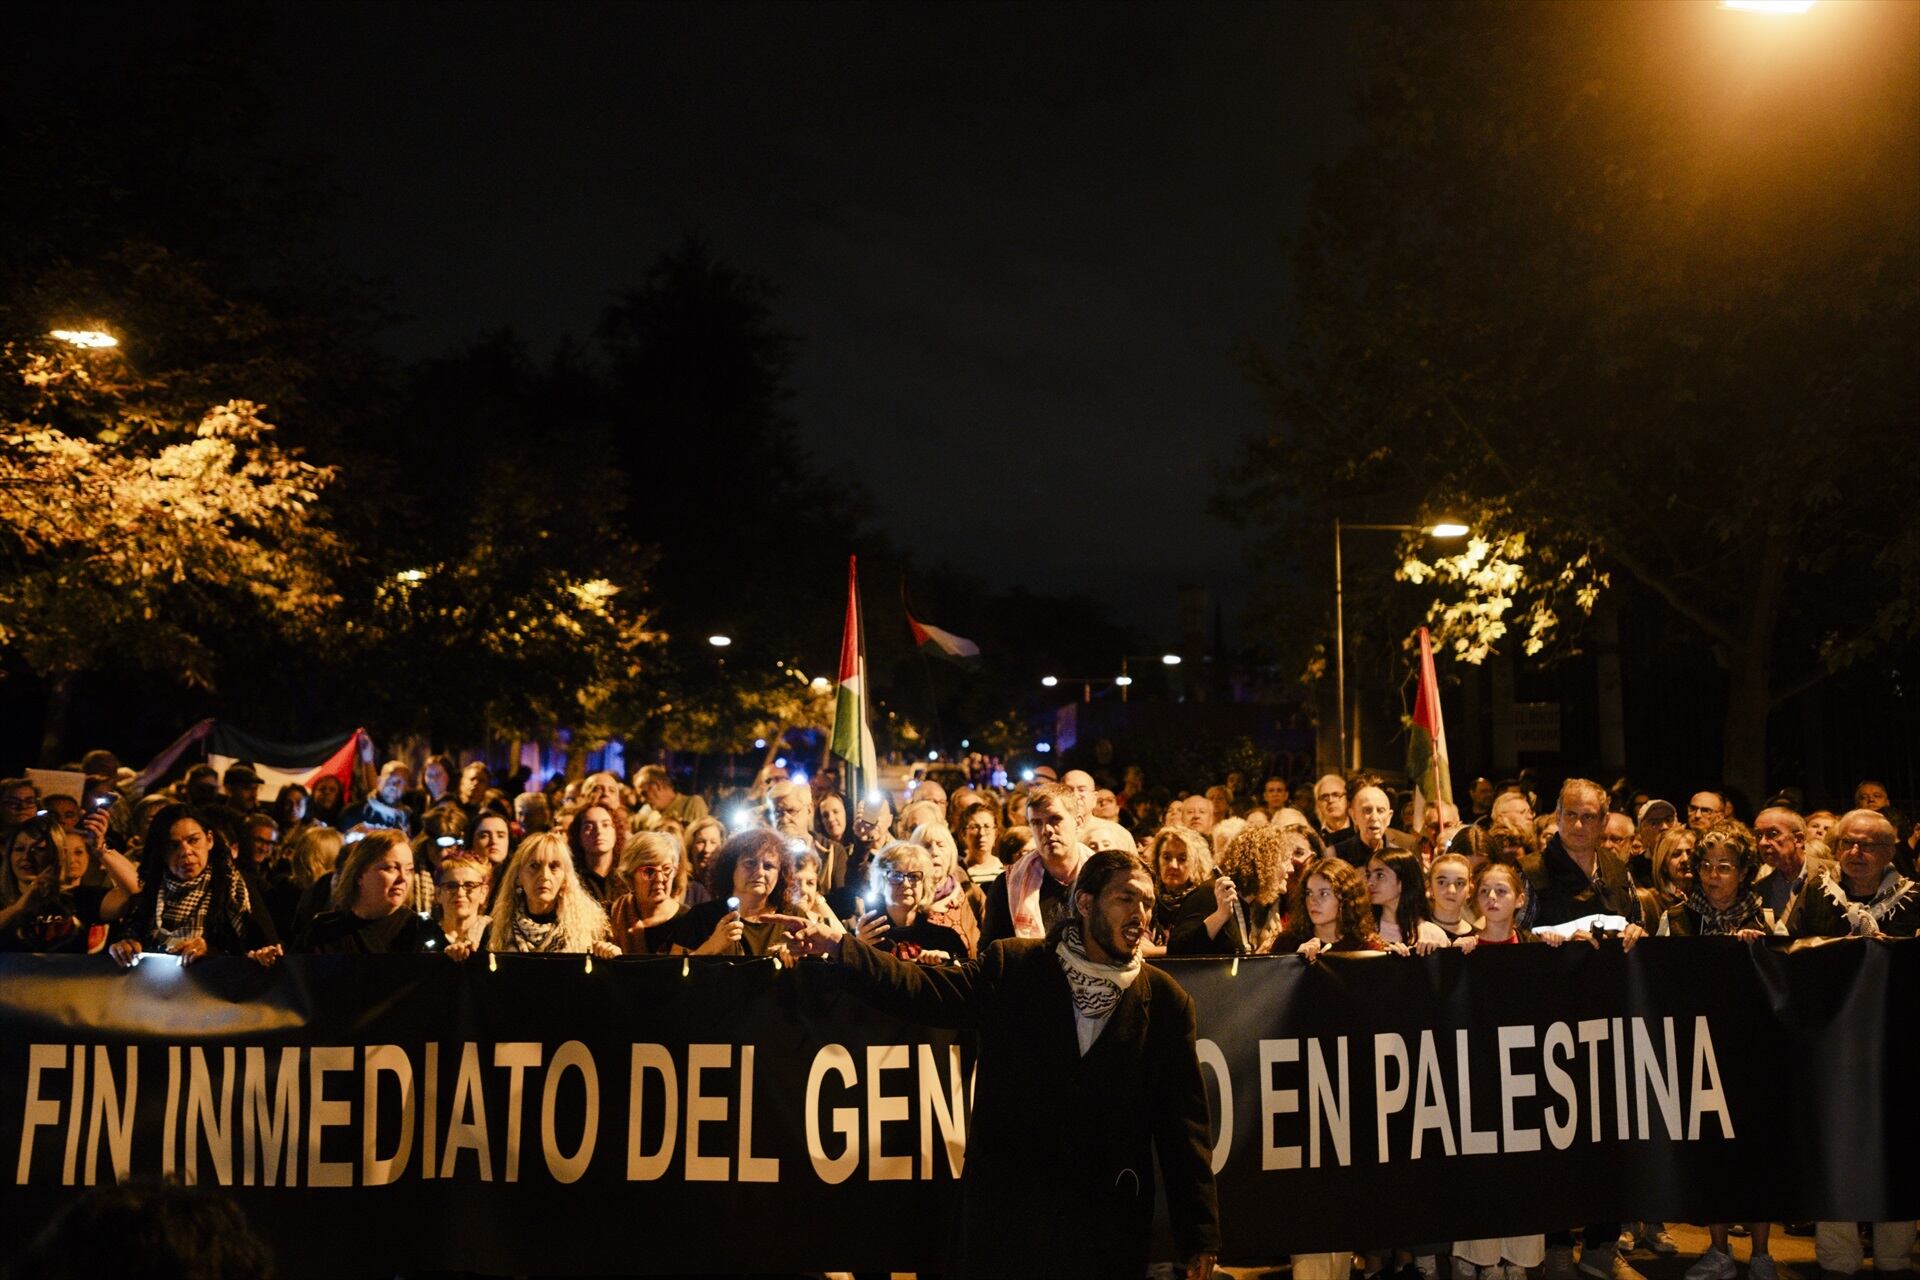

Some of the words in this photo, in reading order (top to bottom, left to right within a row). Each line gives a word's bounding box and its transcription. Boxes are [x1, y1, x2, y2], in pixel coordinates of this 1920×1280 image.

[16, 1044, 138, 1186] FIN
[162, 1040, 600, 1187] INMEDIATO
[626, 1042, 780, 1183] DEL
[1257, 1033, 1352, 1171] EN
[1374, 1015, 1736, 1164] PALESTINA
